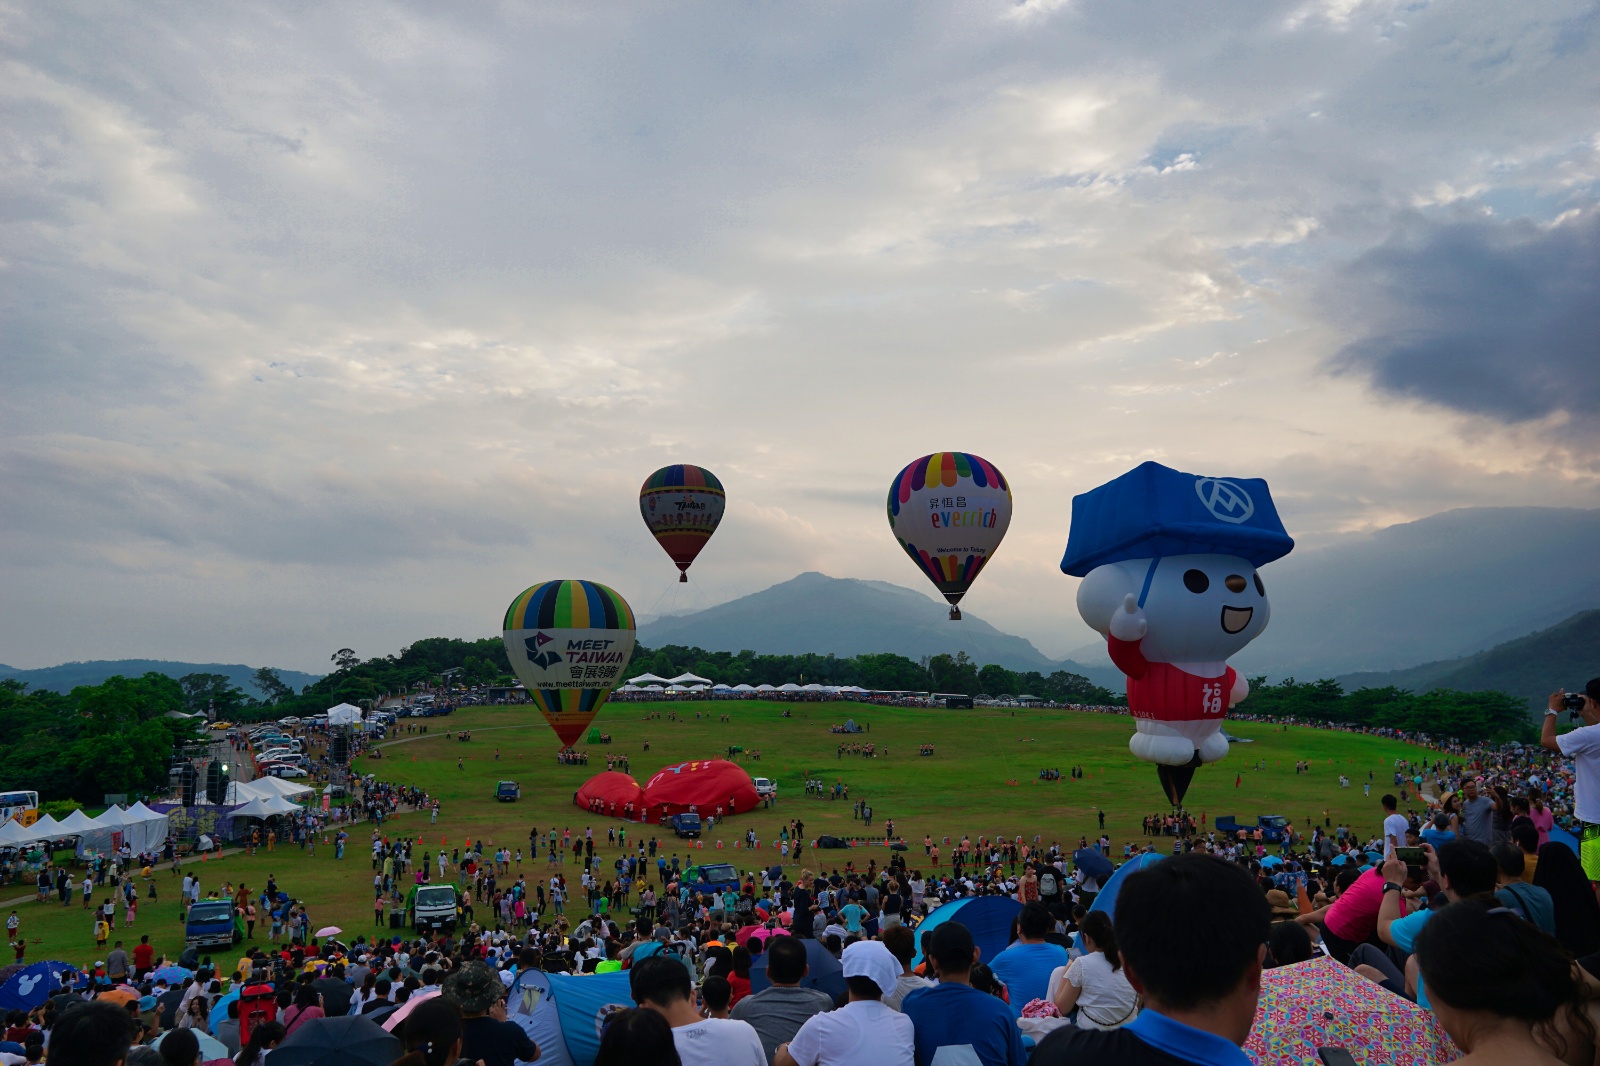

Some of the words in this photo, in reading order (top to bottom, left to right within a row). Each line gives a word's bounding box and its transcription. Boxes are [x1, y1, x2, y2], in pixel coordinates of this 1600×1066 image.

[931, 507, 996, 528] everrich
[567, 640, 614, 650] MEET
[566, 651, 624, 663] TAIWAN
[1202, 682, 1222, 713] 福
